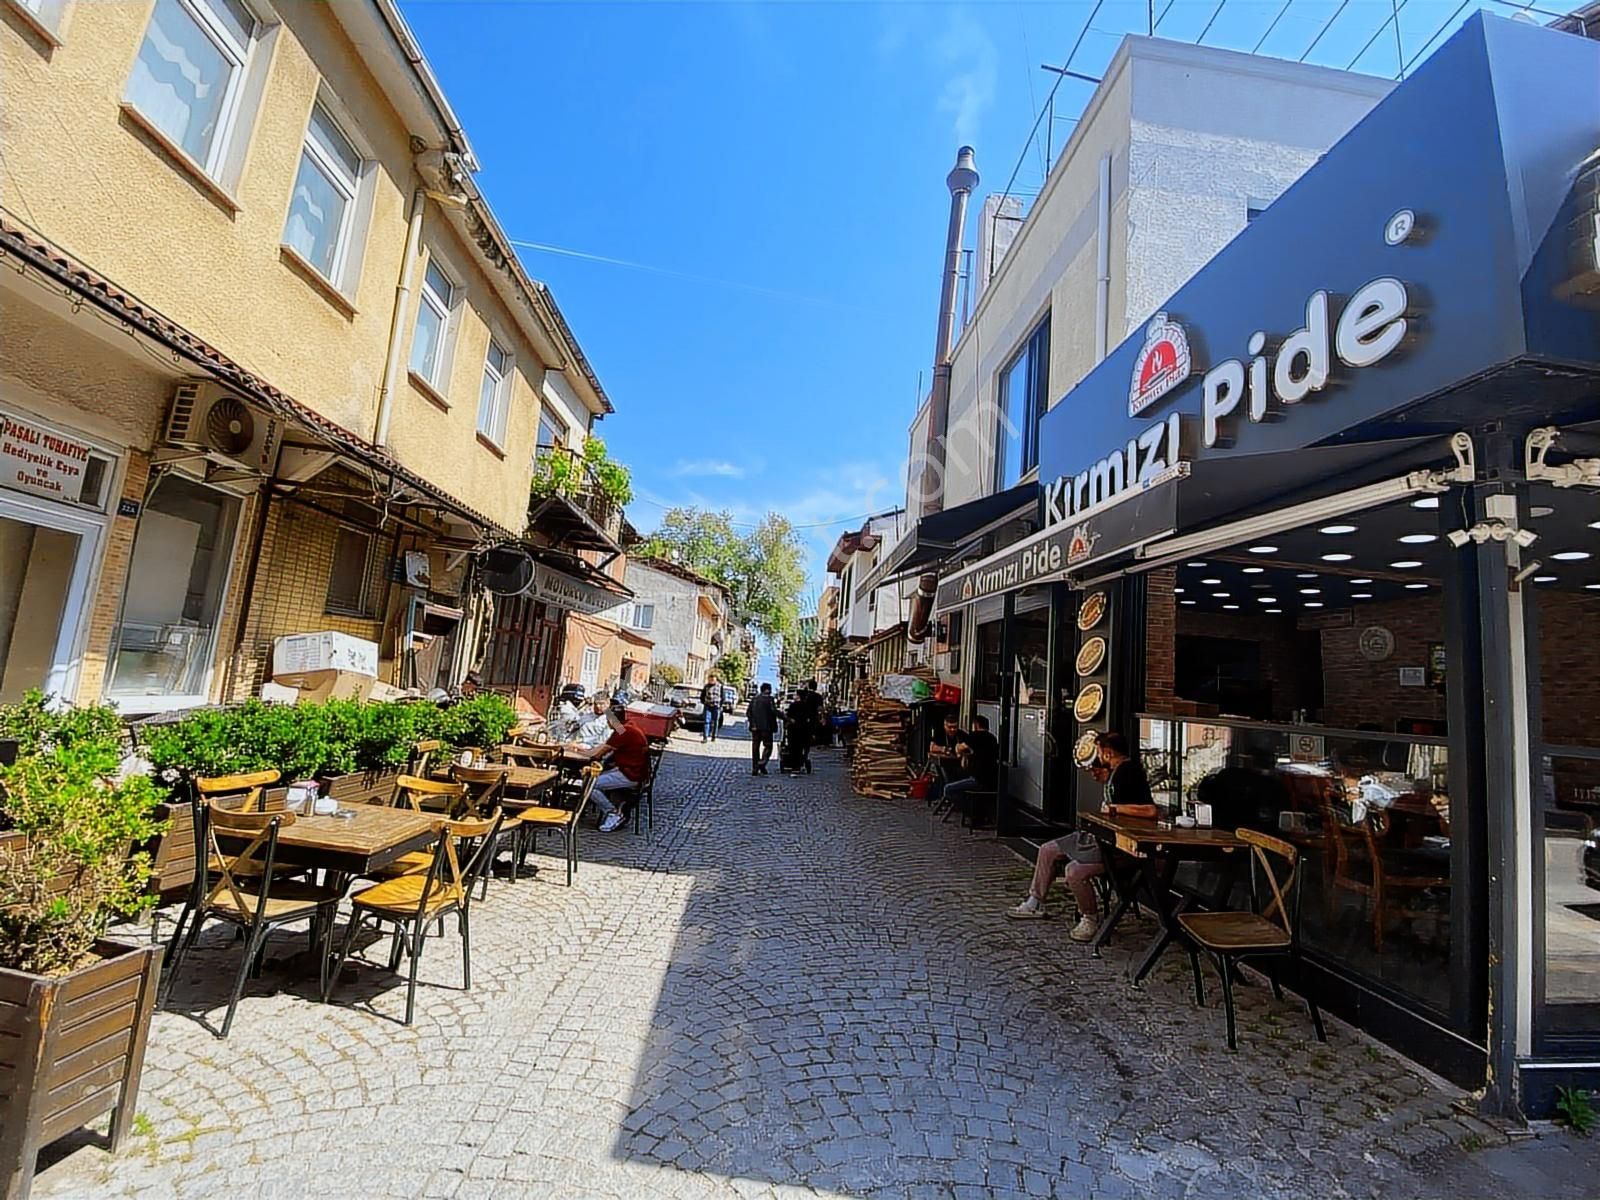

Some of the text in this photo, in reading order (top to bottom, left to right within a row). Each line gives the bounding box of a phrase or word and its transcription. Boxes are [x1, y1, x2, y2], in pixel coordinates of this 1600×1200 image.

[1202, 275, 1408, 449] Pide
[3, 442, 79, 476] Hediyelik Eşya
[36, 468, 48, 478] ve
[17, 471, 62, 491] Oyuncak
[1022, 541, 1061, 580] Pide
